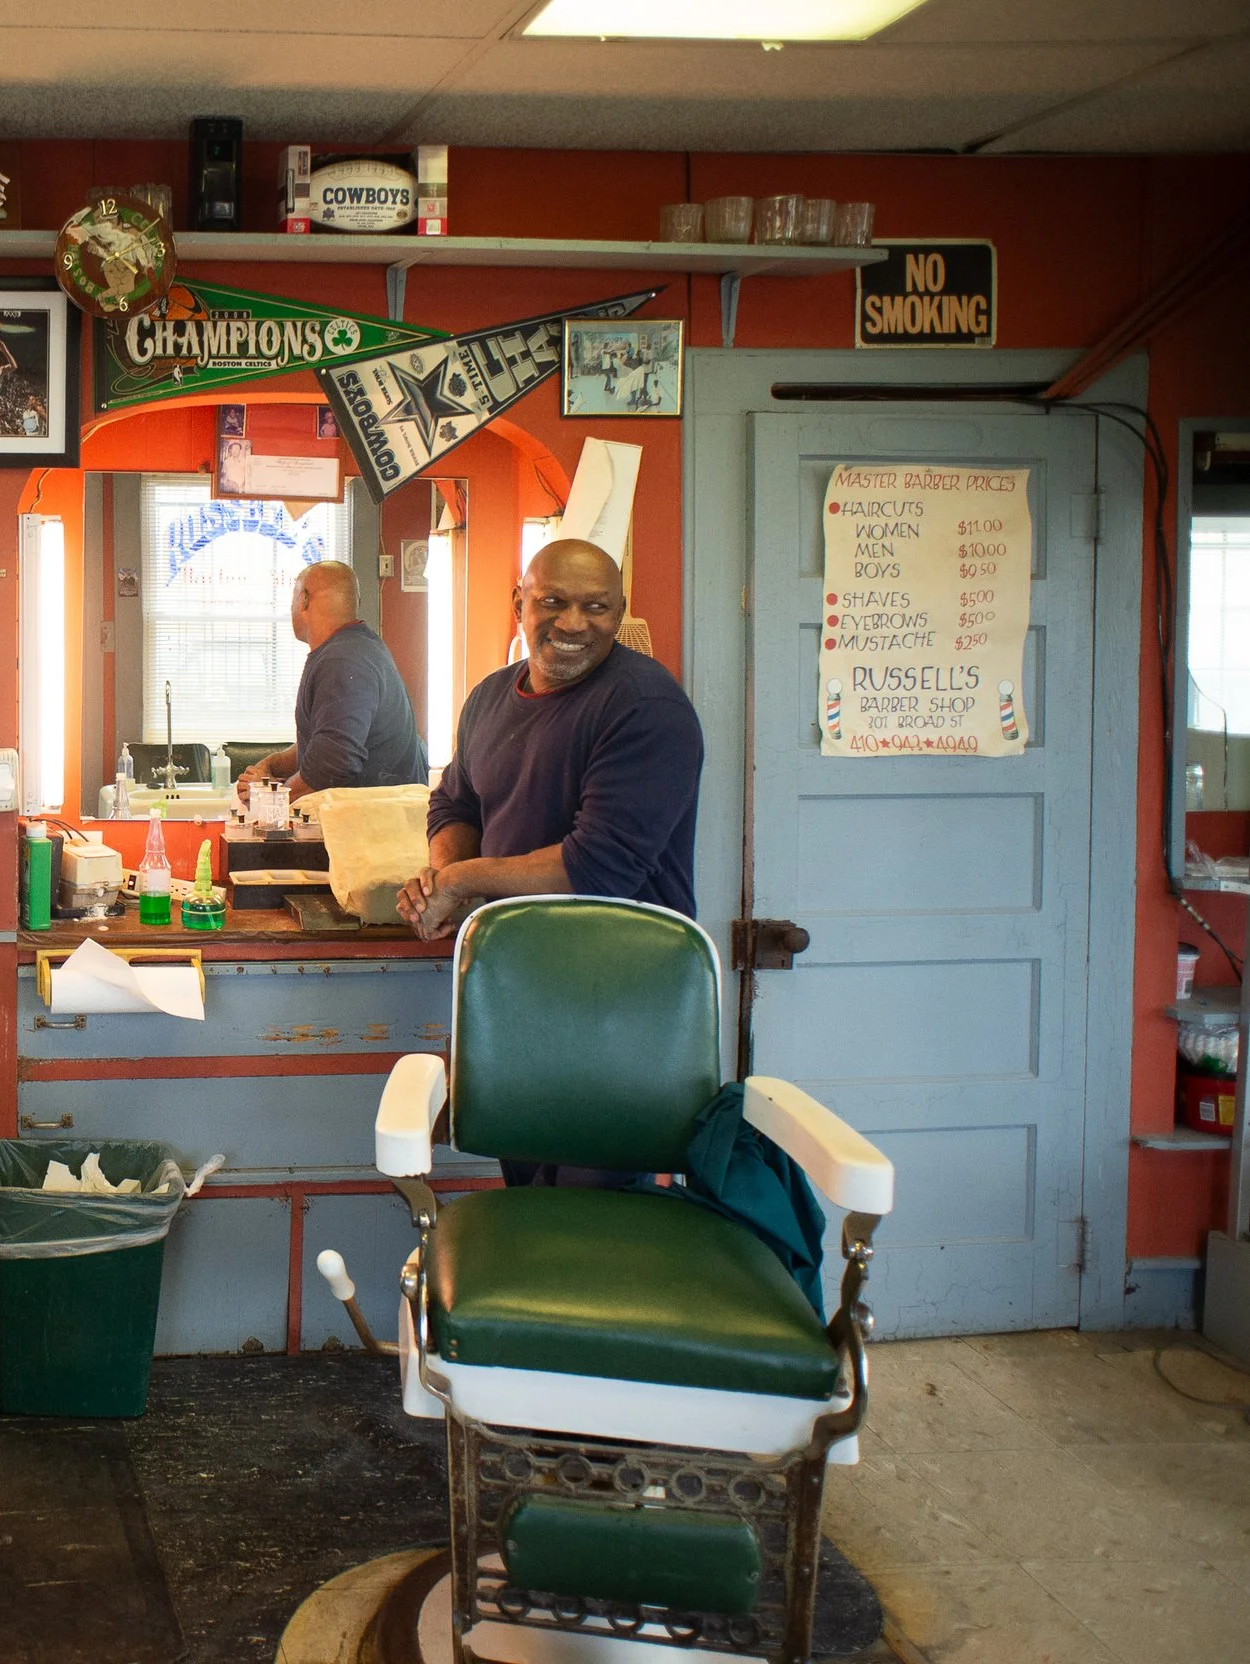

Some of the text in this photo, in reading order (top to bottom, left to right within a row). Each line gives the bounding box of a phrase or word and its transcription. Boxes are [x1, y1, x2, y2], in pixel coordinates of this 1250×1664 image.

[323, 187, 410, 206] COWBOYS
[101, 198, 118, 216] 12
[157, 242, 166, 257] 3
[63, 254, 73, 270] 9
[906, 253, 945, 293] NO
[119, 296, 128, 311] 6
[214, 311, 248, 319] 2008
[865, 295, 987, 334] SMOKING
[327, 319, 358, 336] CELTICS
[124, 313, 323, 369] CHAMPIONS
[458, 348, 491, 408] 5-TIME
[336, 370, 401, 482] COWBOYS
[834, 472, 1015, 491] MASTER BARBER PRICES
[840, 501, 924, 517] HAIRCUTS
[855, 522, 919, 540] WOMEN
[854, 543, 894, 558] MEN
[854, 562, 900, 579] BOYS
[842, 592, 910, 609] SHAVES
[840, 612, 928, 630] EYEBROWS
[838, 631, 936, 651] MUSTACHE
[852, 666, 979, 692] RUSSELL'S
[860, 696, 975, 713] BARBER SHOP
[898, 715, 946, 729] BROAD
[950, 715, 965, 729] ST
